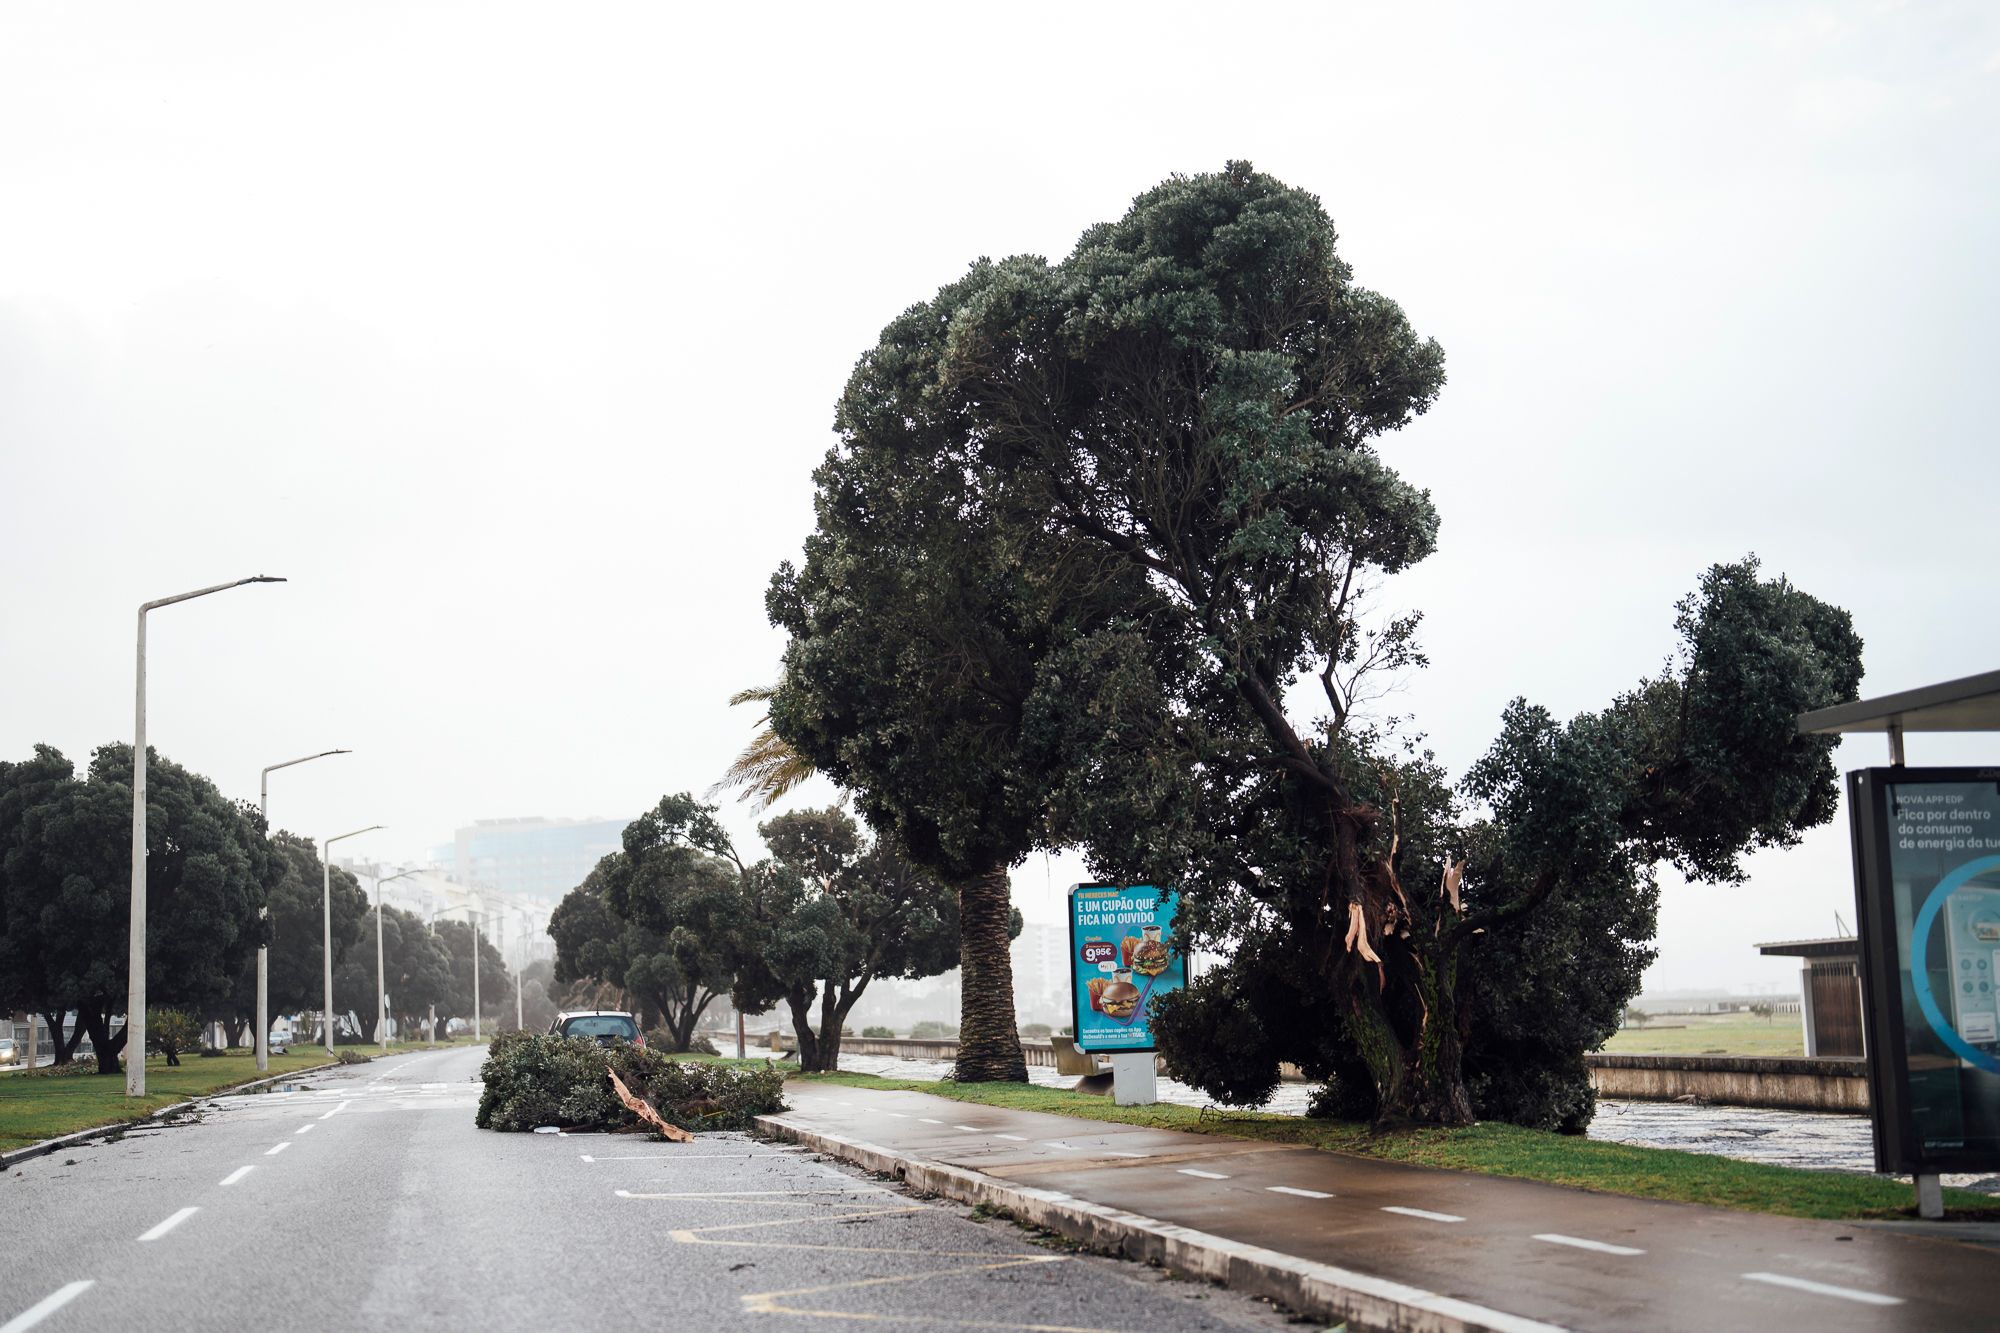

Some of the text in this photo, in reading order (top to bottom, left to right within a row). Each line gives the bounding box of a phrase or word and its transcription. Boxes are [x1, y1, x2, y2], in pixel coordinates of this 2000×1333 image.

[1896, 795, 1964, 804] NOVA APP EDP
[1897, 808, 1991, 822] Fica por dentro
[1898, 824, 1973, 834] do consumo
[1899, 837, 1915, 848] de
[1917, 836, 1965, 852] energia
[1966, 837, 1983, 848] da
[1078, 896, 1155, 912] E UM CUPÃO QUE
[1078, 912, 1154, 926] FICA NO OUVIDO
